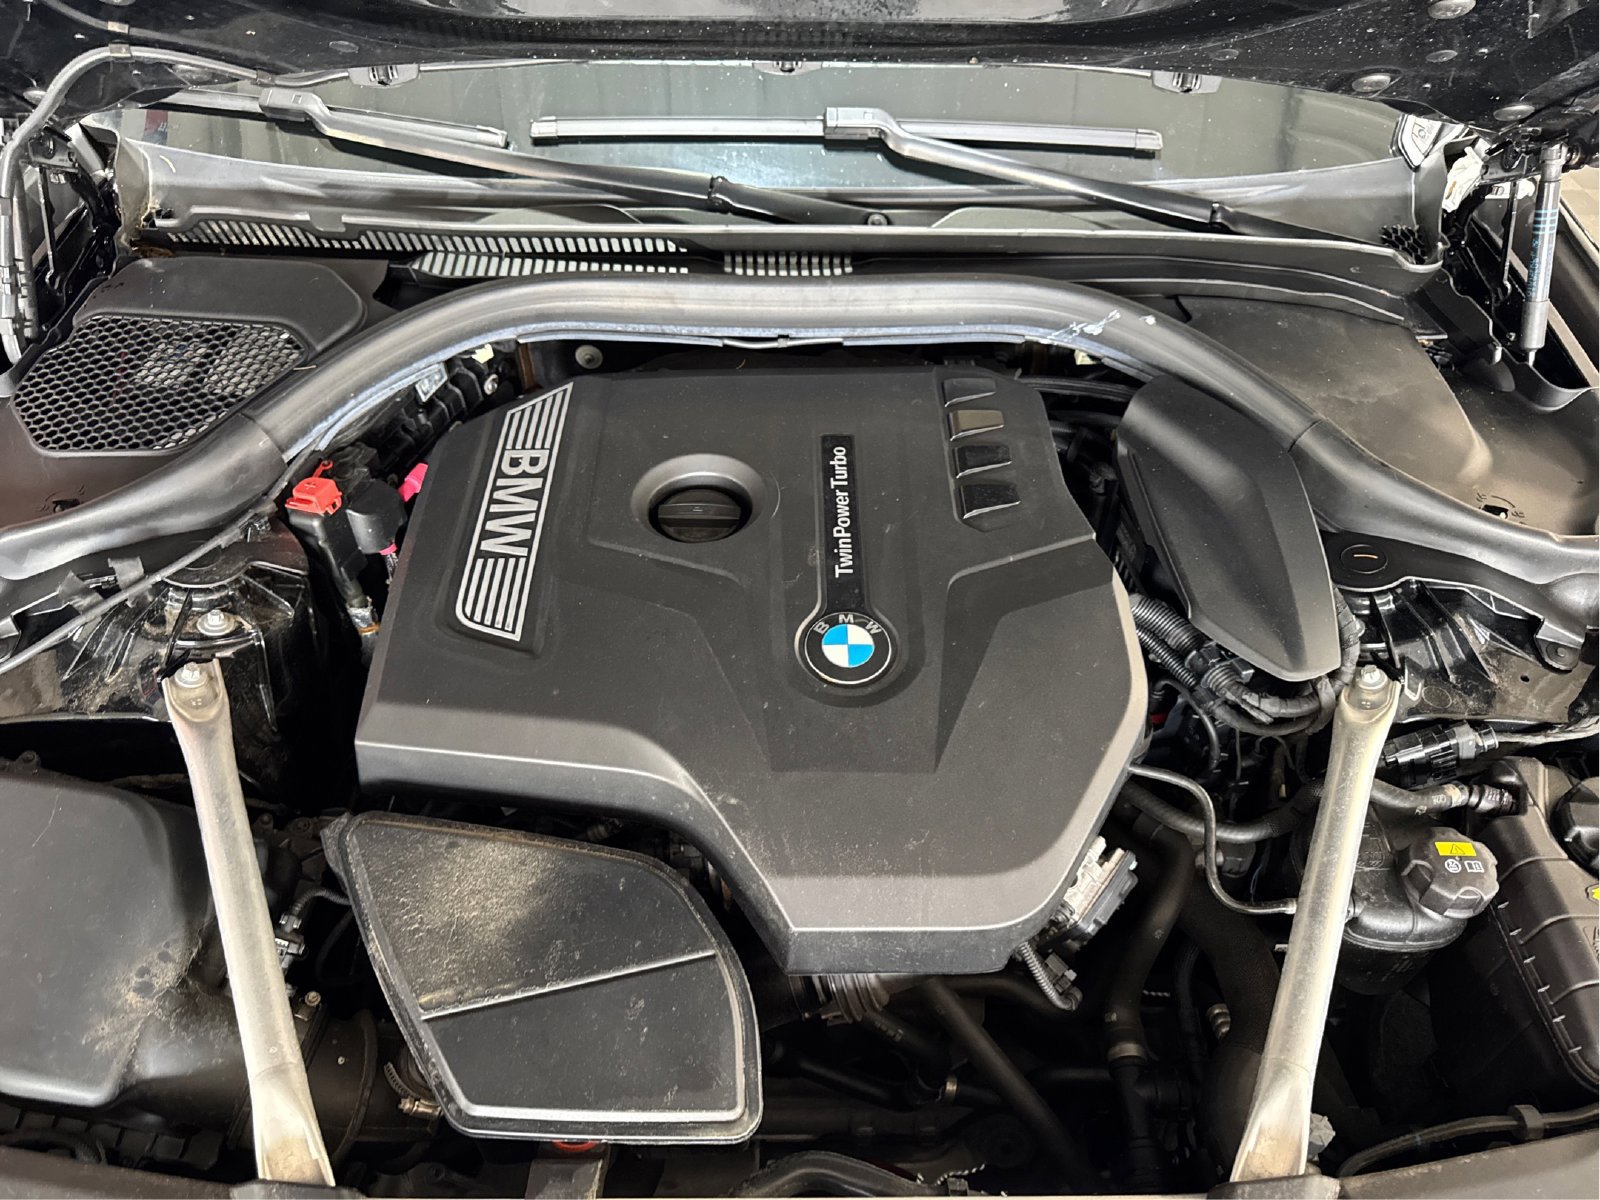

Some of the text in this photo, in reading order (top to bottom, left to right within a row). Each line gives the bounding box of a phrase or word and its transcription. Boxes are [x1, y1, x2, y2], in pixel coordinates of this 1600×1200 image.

[480, 449, 550, 556] BMW
[829, 446, 854, 579] TwinPower Turbo
[813, 613, 882, 635] BMW
